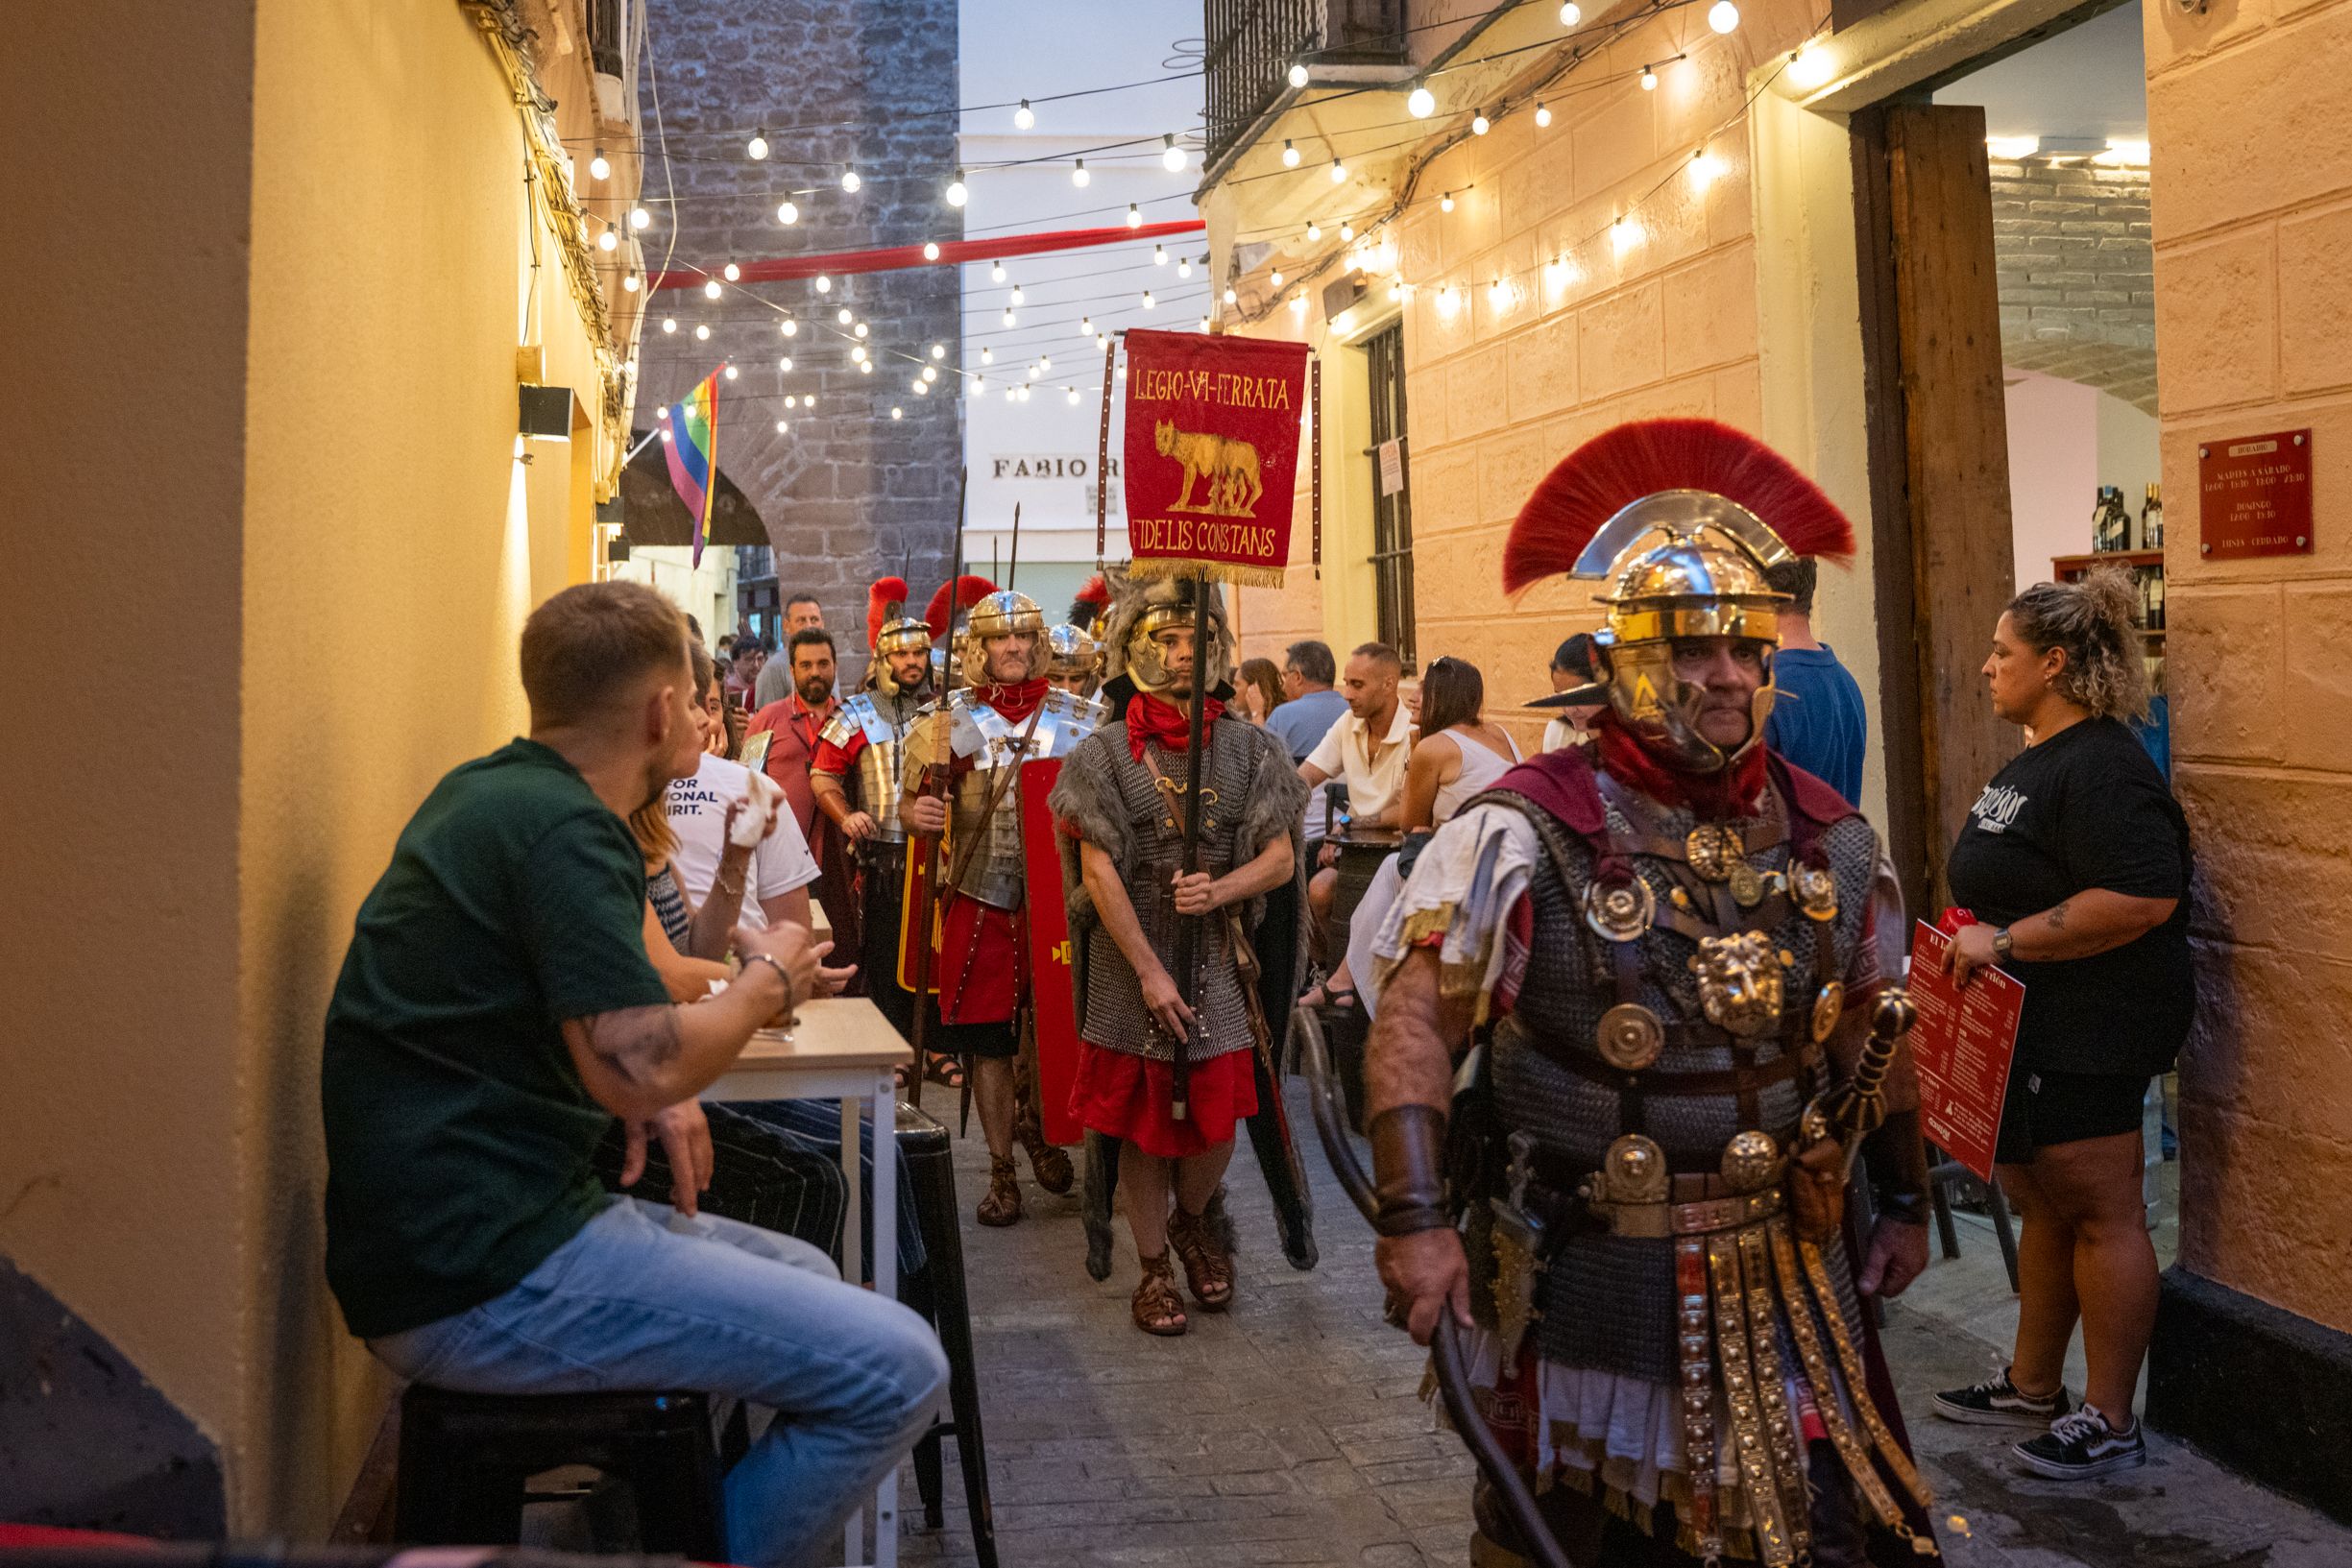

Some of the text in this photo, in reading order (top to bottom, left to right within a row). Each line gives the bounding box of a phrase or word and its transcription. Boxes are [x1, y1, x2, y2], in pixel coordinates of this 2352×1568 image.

[993, 458, 1087, 478] FABIO
[1132, 519, 1276, 558] FIDELIS CONSTANS
